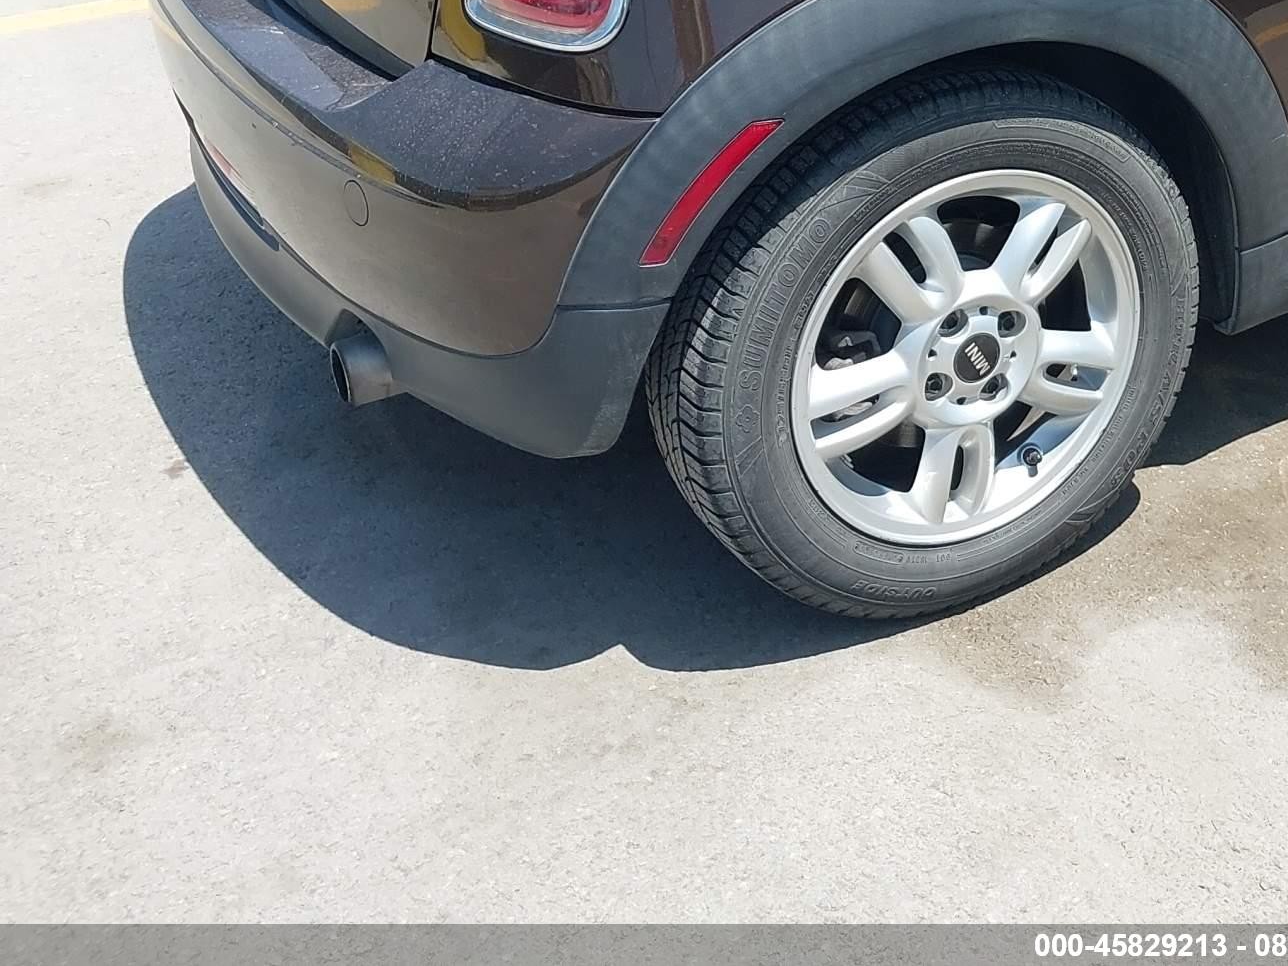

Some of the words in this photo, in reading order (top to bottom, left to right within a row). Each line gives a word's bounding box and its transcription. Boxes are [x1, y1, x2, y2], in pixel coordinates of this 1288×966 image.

[737, 218, 832, 392] SUMITOMO
[964, 341, 991, 376] MINI
[851, 578, 938, 600] OUTSIDE
